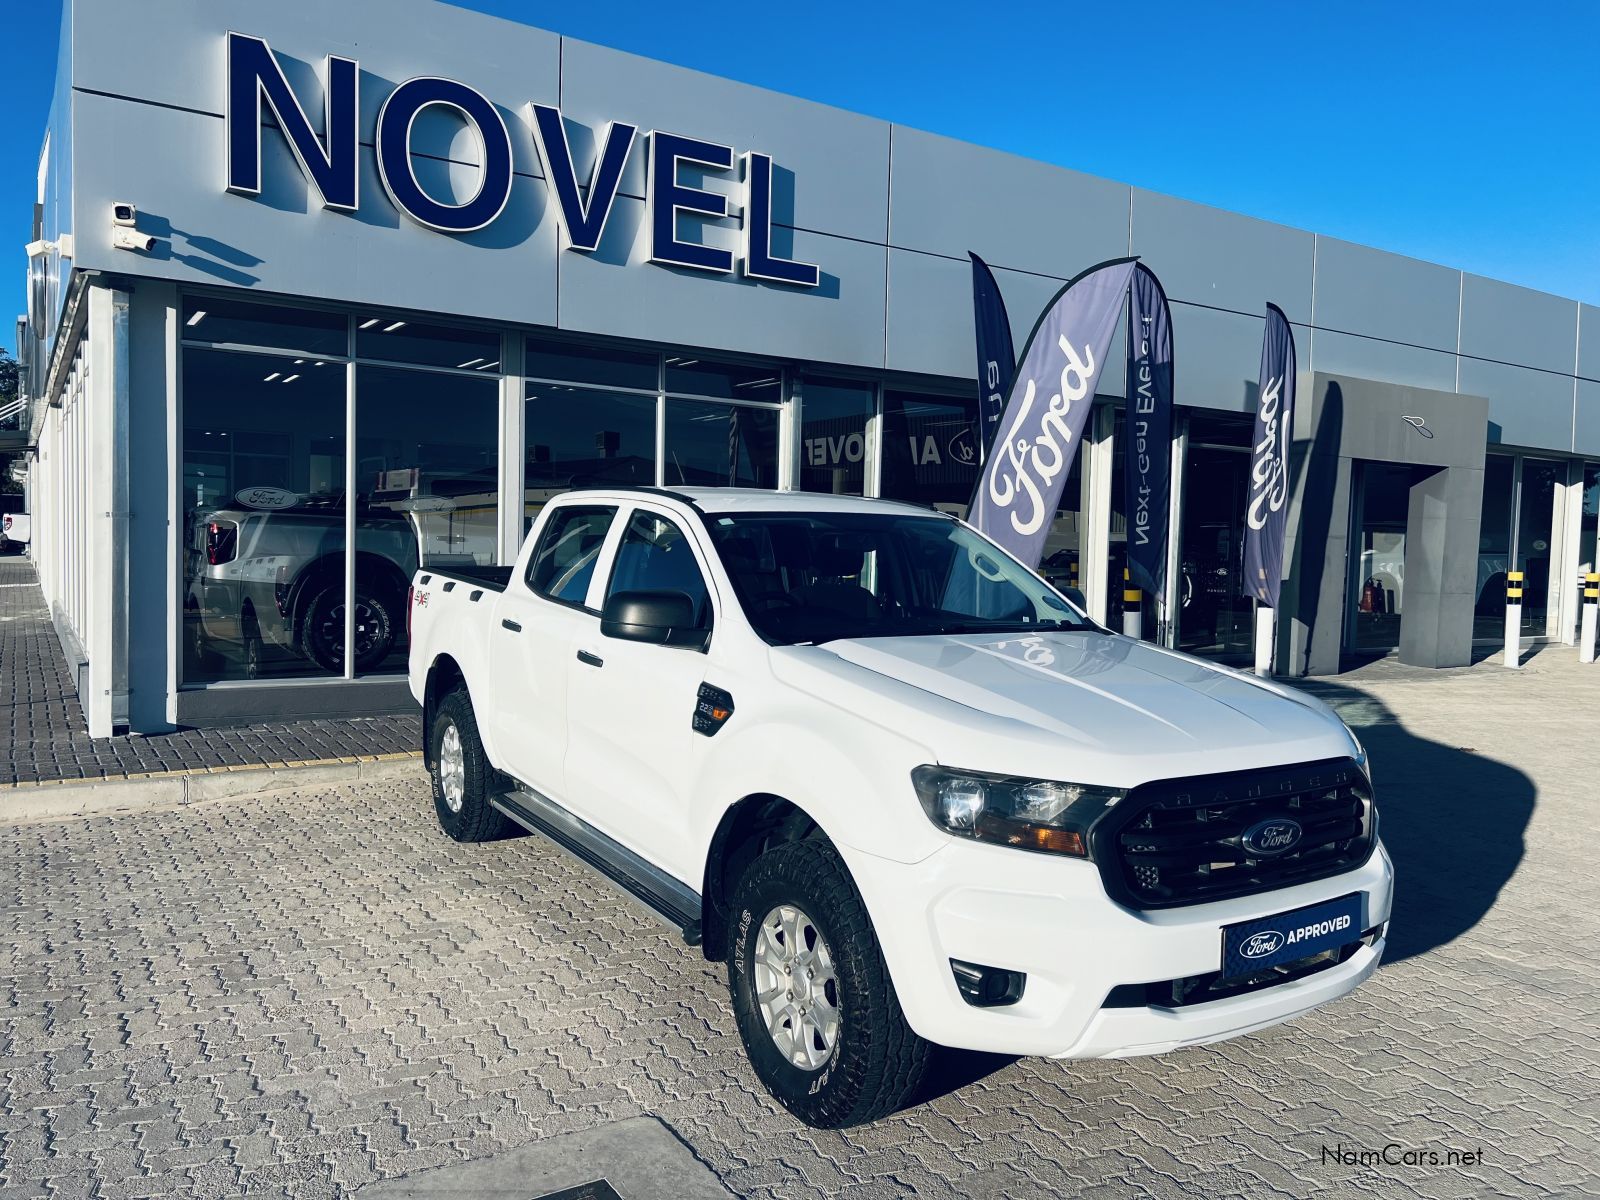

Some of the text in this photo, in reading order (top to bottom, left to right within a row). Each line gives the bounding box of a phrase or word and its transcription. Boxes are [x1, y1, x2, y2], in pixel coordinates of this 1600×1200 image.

[224, 29, 820, 288] NOVEL
[989, 333, 1096, 537] Ford
[1260, 825, 1293, 848] Ford
[734, 909, 752, 974] ATLAS
[1247, 914, 1351, 956] Ford APPROVED
